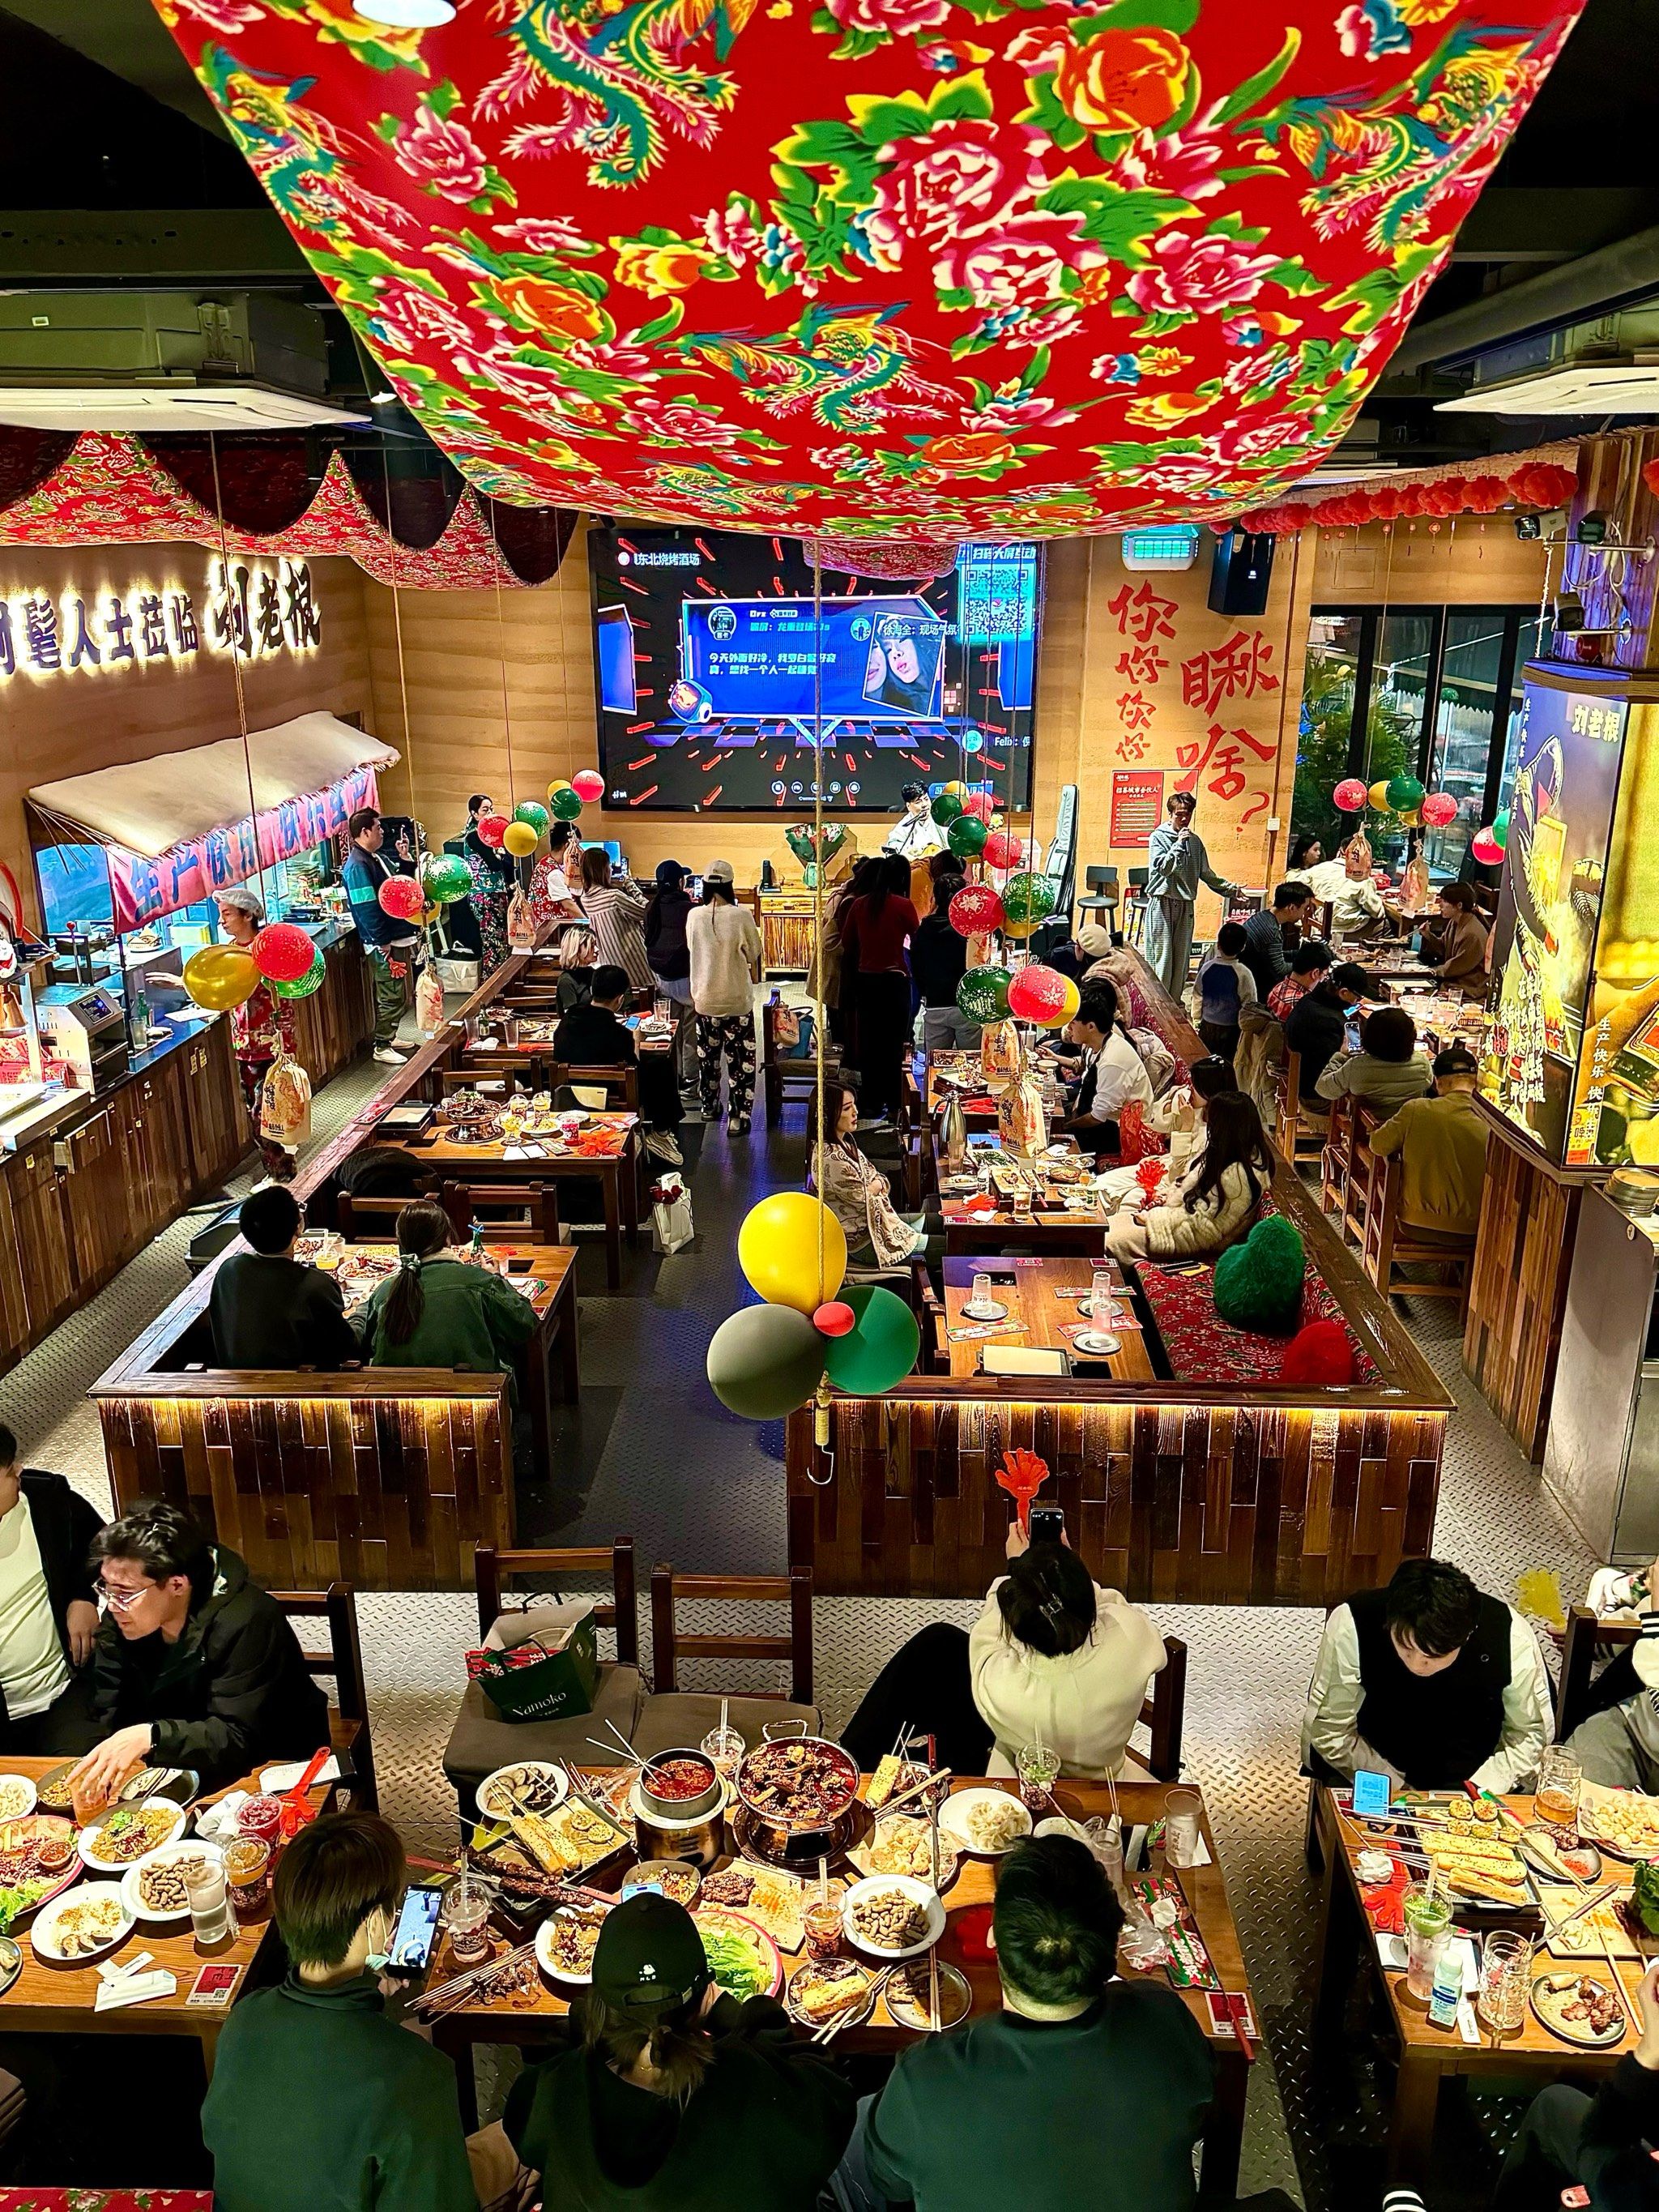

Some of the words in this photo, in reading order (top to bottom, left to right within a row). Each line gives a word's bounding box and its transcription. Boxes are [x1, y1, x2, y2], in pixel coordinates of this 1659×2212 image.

[1572, 703, 1621, 743] 刘老根
[1590, 1016, 1612, 1079] 生产快乐
